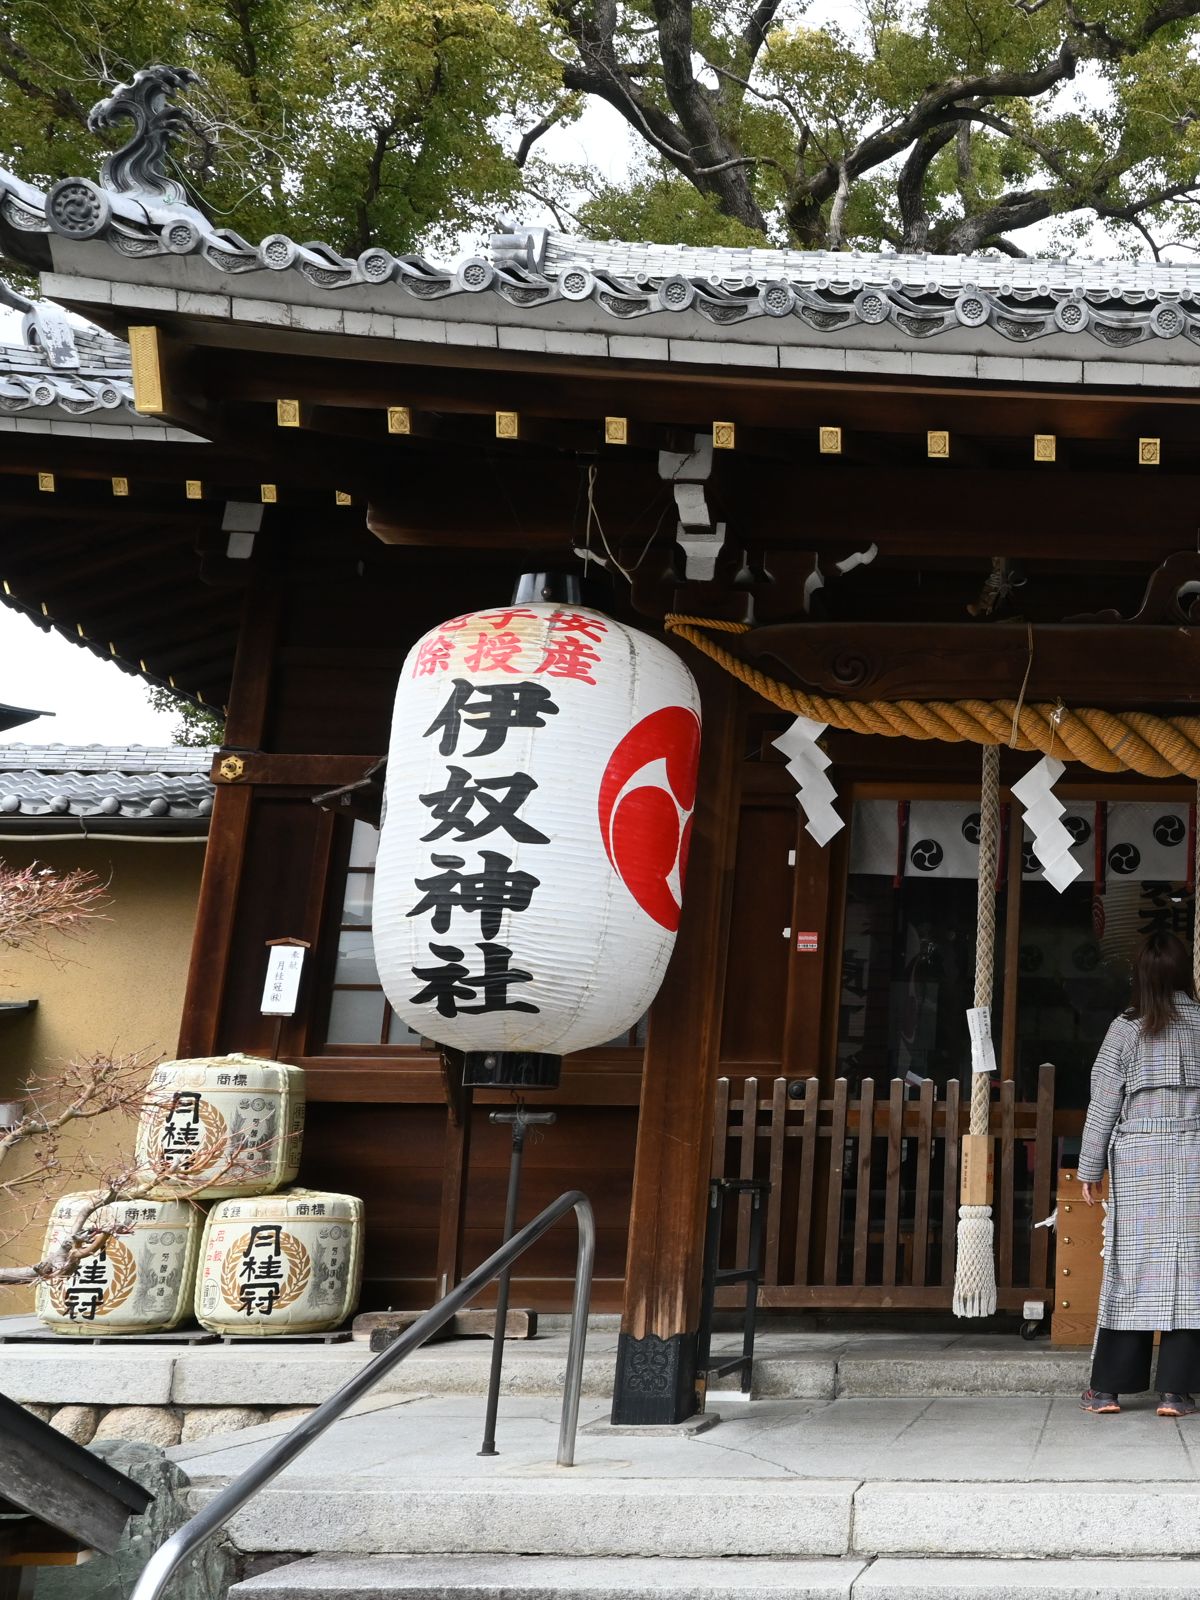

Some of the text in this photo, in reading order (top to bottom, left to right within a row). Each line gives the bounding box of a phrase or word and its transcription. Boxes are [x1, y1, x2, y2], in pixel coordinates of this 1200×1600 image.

[464, 608, 539, 675] 子授
[405, 678, 560, 1019] 伊奴神社
[216, 1073, 248, 1086] 商標
[125, 1207, 156, 1220] 商標
[296, 1203, 325, 1216] 商標
[64, 1247, 108, 1320] 桂冠
[237, 1224, 284, 1316] 月桂冠
